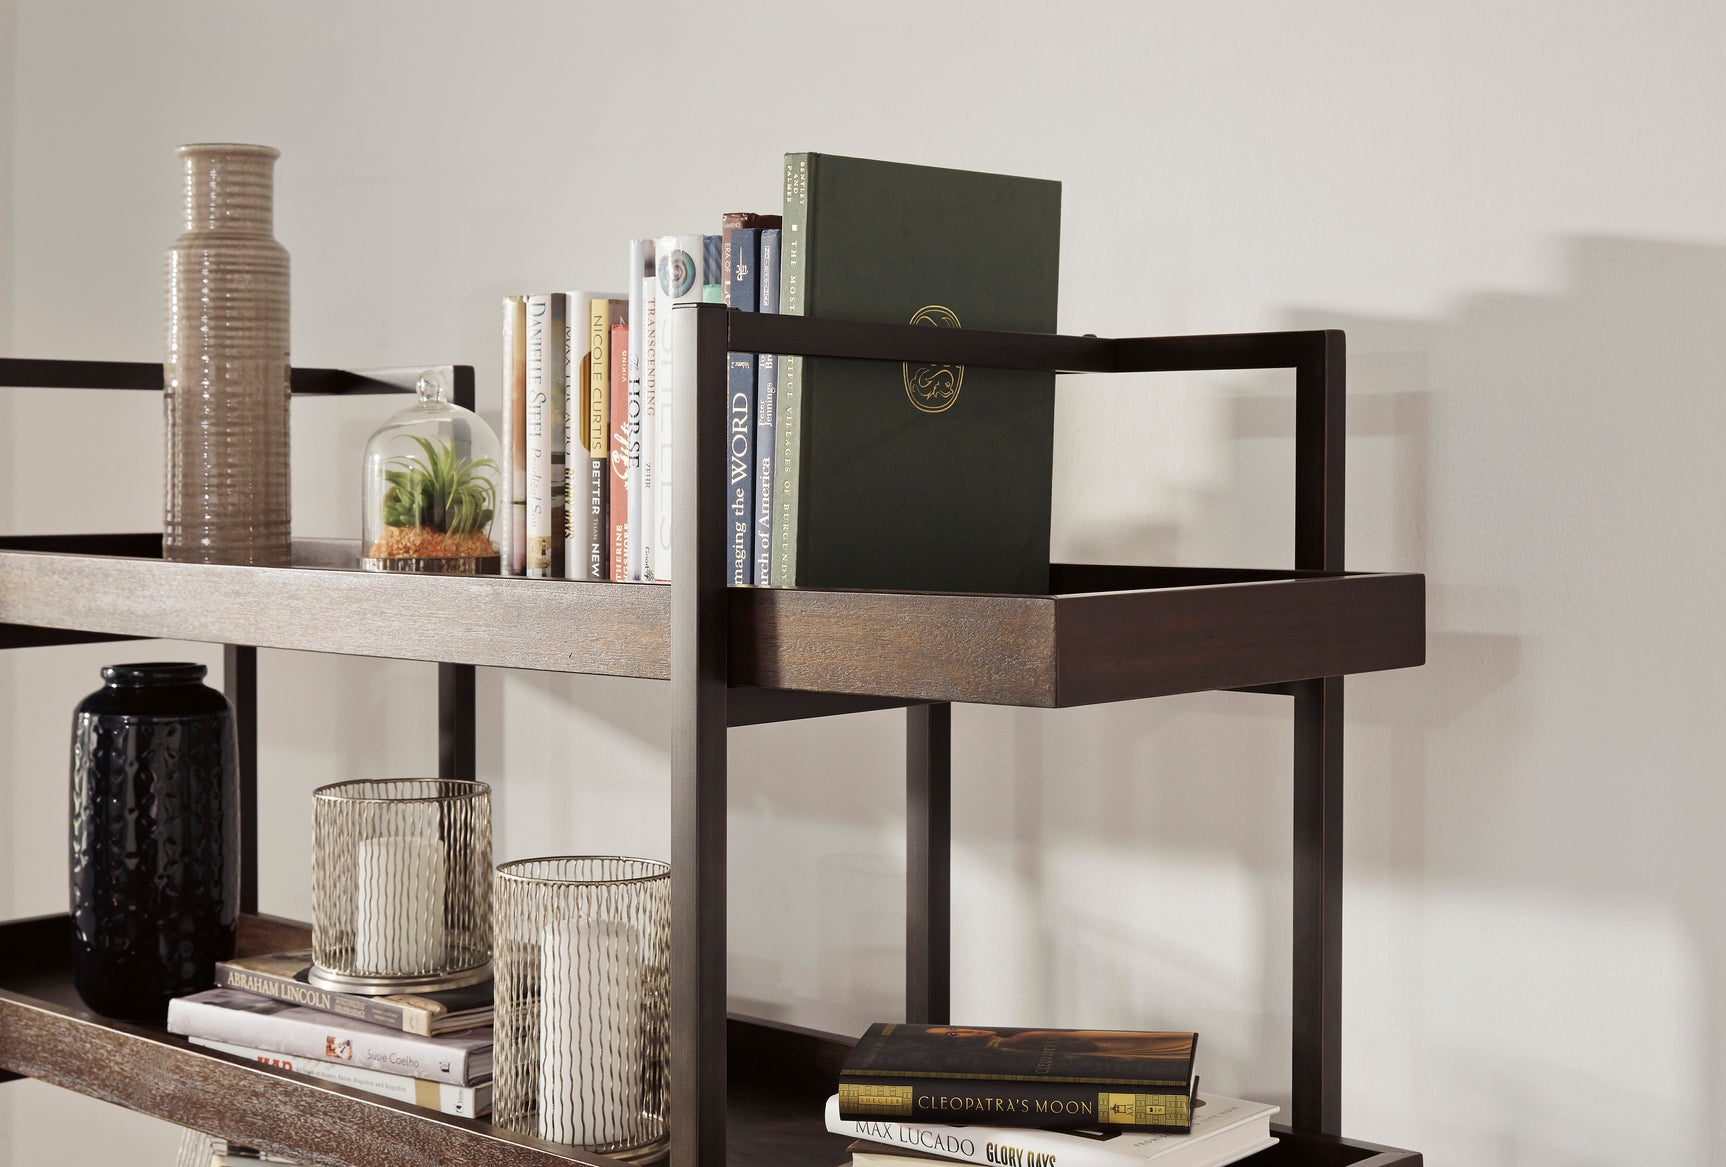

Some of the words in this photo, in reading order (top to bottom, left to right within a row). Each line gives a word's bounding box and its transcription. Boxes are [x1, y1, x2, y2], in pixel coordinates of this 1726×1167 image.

[789, 275, 797, 311] MOST
[529, 302, 547, 384] DANIELLE
[592, 315, 604, 381] NICOLE
[647, 298, 656, 416] TRANSCENDING
[592, 387, 603, 450] CURTIS
[628, 378, 641, 468] HORSE
[765, 382, 776, 427] Jennings
[731, 392, 748, 485] WORD
[785, 406, 793, 472] VILLAGES
[592, 460, 601, 515] BETTER
[732, 488, 744, 516] the
[758, 457, 771, 528] America
[784, 480, 791, 495] OF
[591, 543, 600, 577] NEW
[733, 522, 746, 585] maging
[758, 530, 769, 549] of
[227, 971, 279, 997] ABRAHAM
[281, 983, 331, 1009] LINCOLN
[367, 1049, 387, 1063] Susie
[389, 1053, 420, 1069] Coelho
[918, 1095, 1029, 1113] CLEOPATRA'S
[1035, 1099, 1093, 1115] MOON
[855, 1120, 893, 1140] MAX
[899, 1126, 975, 1157] LUCADO
[986, 1141, 1023, 1167] GLORY
[1027, 1149, 1056, 1167] DAYS
